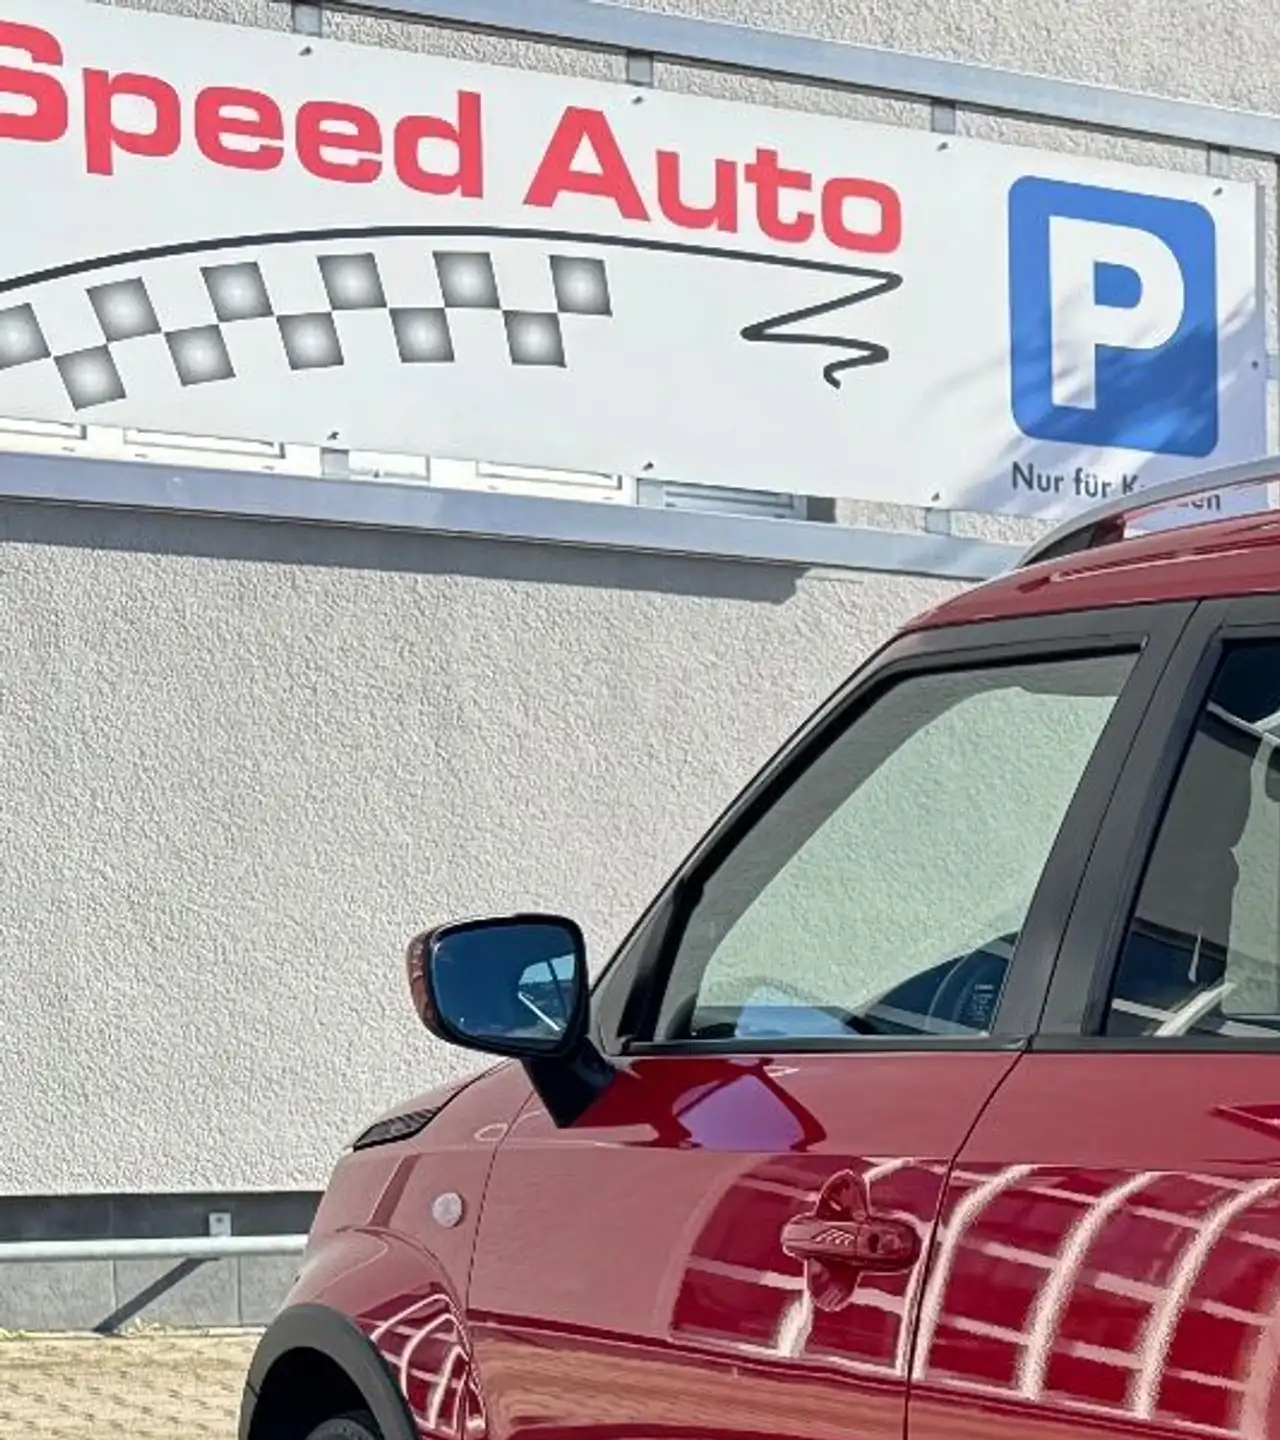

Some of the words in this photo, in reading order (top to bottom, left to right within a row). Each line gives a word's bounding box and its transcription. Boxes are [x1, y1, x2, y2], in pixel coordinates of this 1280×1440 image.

[523, 106, 902, 254] Auto
[1047, 215, 1186, 411] P
[1011, 461, 1064, 494] Nur
[1072, 467, 1113, 499] für
